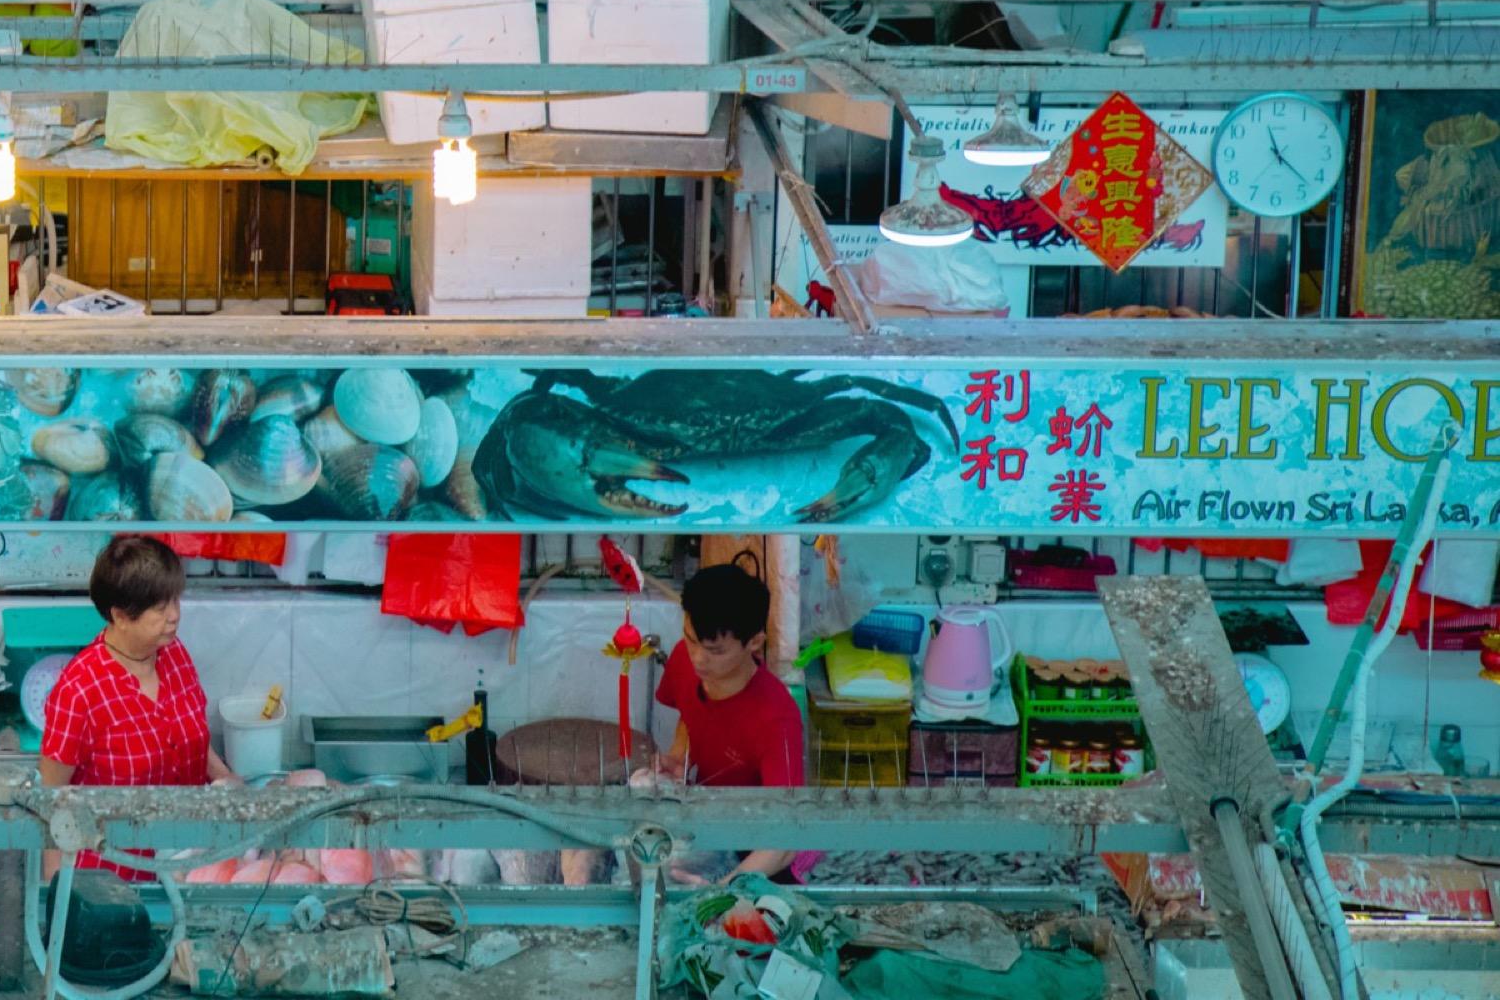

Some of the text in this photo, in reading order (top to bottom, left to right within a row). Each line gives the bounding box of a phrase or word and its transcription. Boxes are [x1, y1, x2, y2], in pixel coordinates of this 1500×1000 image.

[755, 74, 797, 89] 01-43
[915, 115, 992, 134] Specialis
[1135, 377, 1281, 460] LEE
[1131, 490, 1480, 526] Air Flown Sri Laka,
